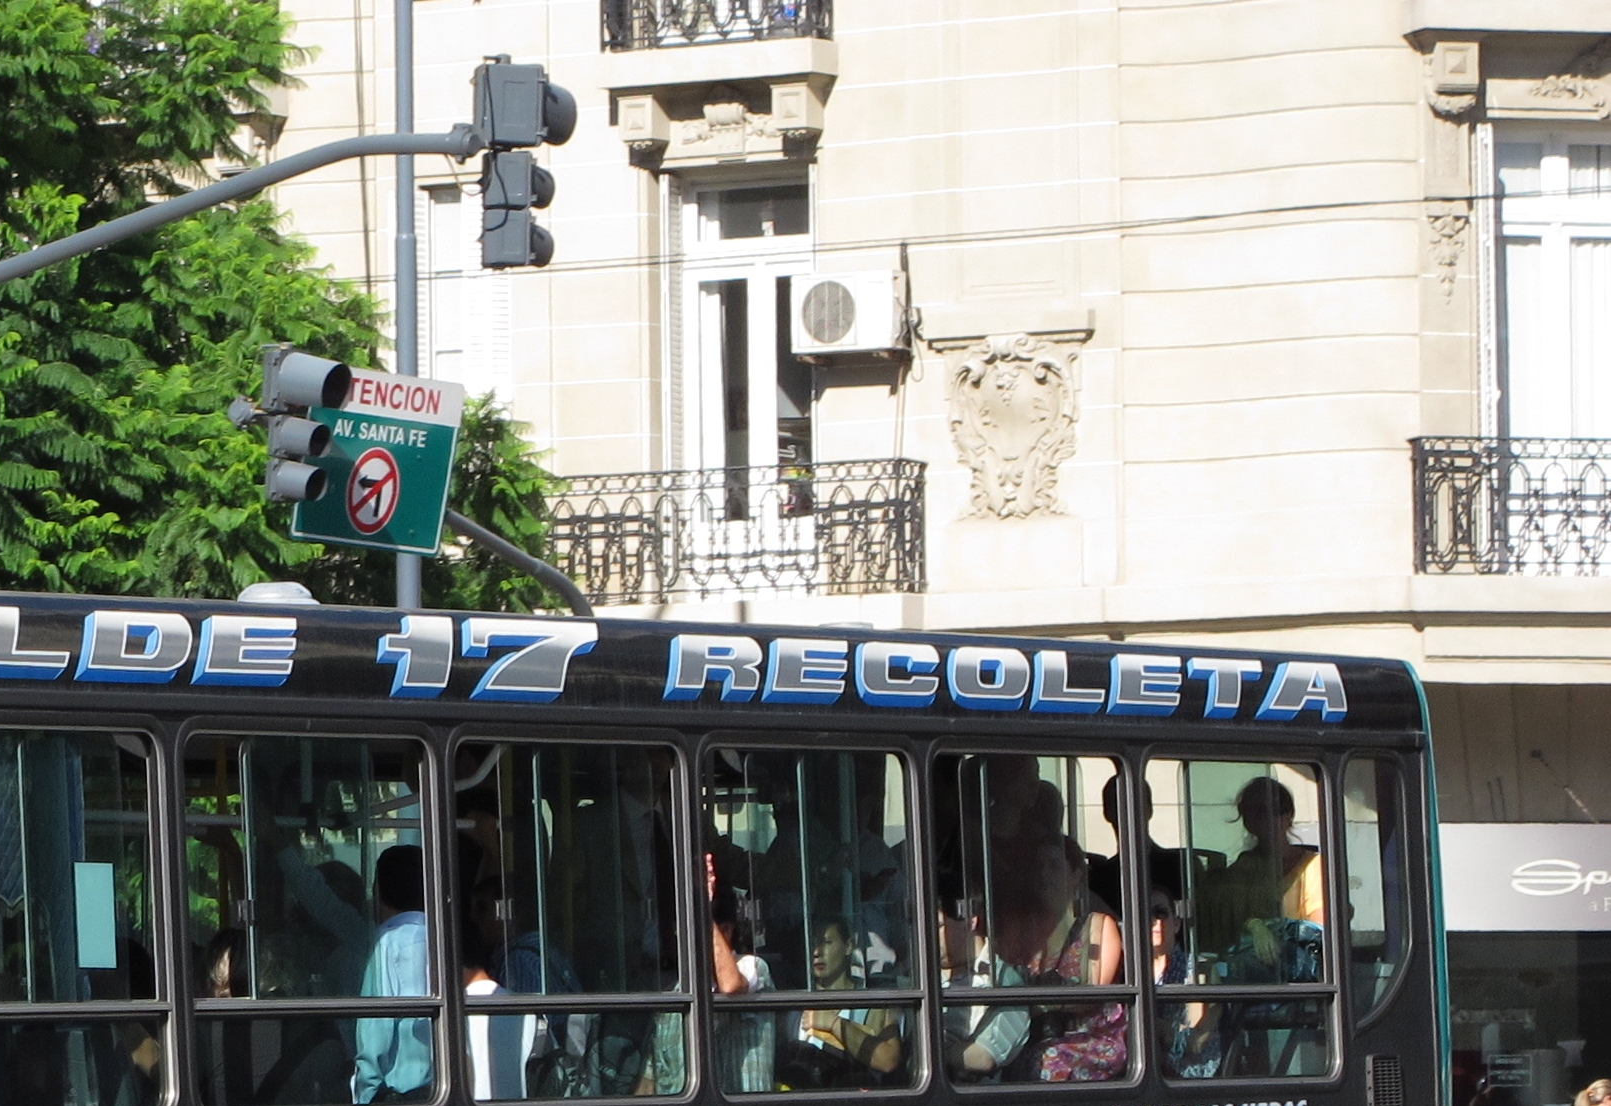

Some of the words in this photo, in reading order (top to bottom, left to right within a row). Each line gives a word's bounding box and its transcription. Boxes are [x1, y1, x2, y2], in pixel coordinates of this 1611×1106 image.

[349, 377, 441, 414] TENCION
[333, 419, 355, 438] AV.
[358, 422, 404, 445] SANTA
[408, 429, 428, 448] FE
[376, 615, 598, 704] 17
[663, 634, 1348, 722] RECOLETA
